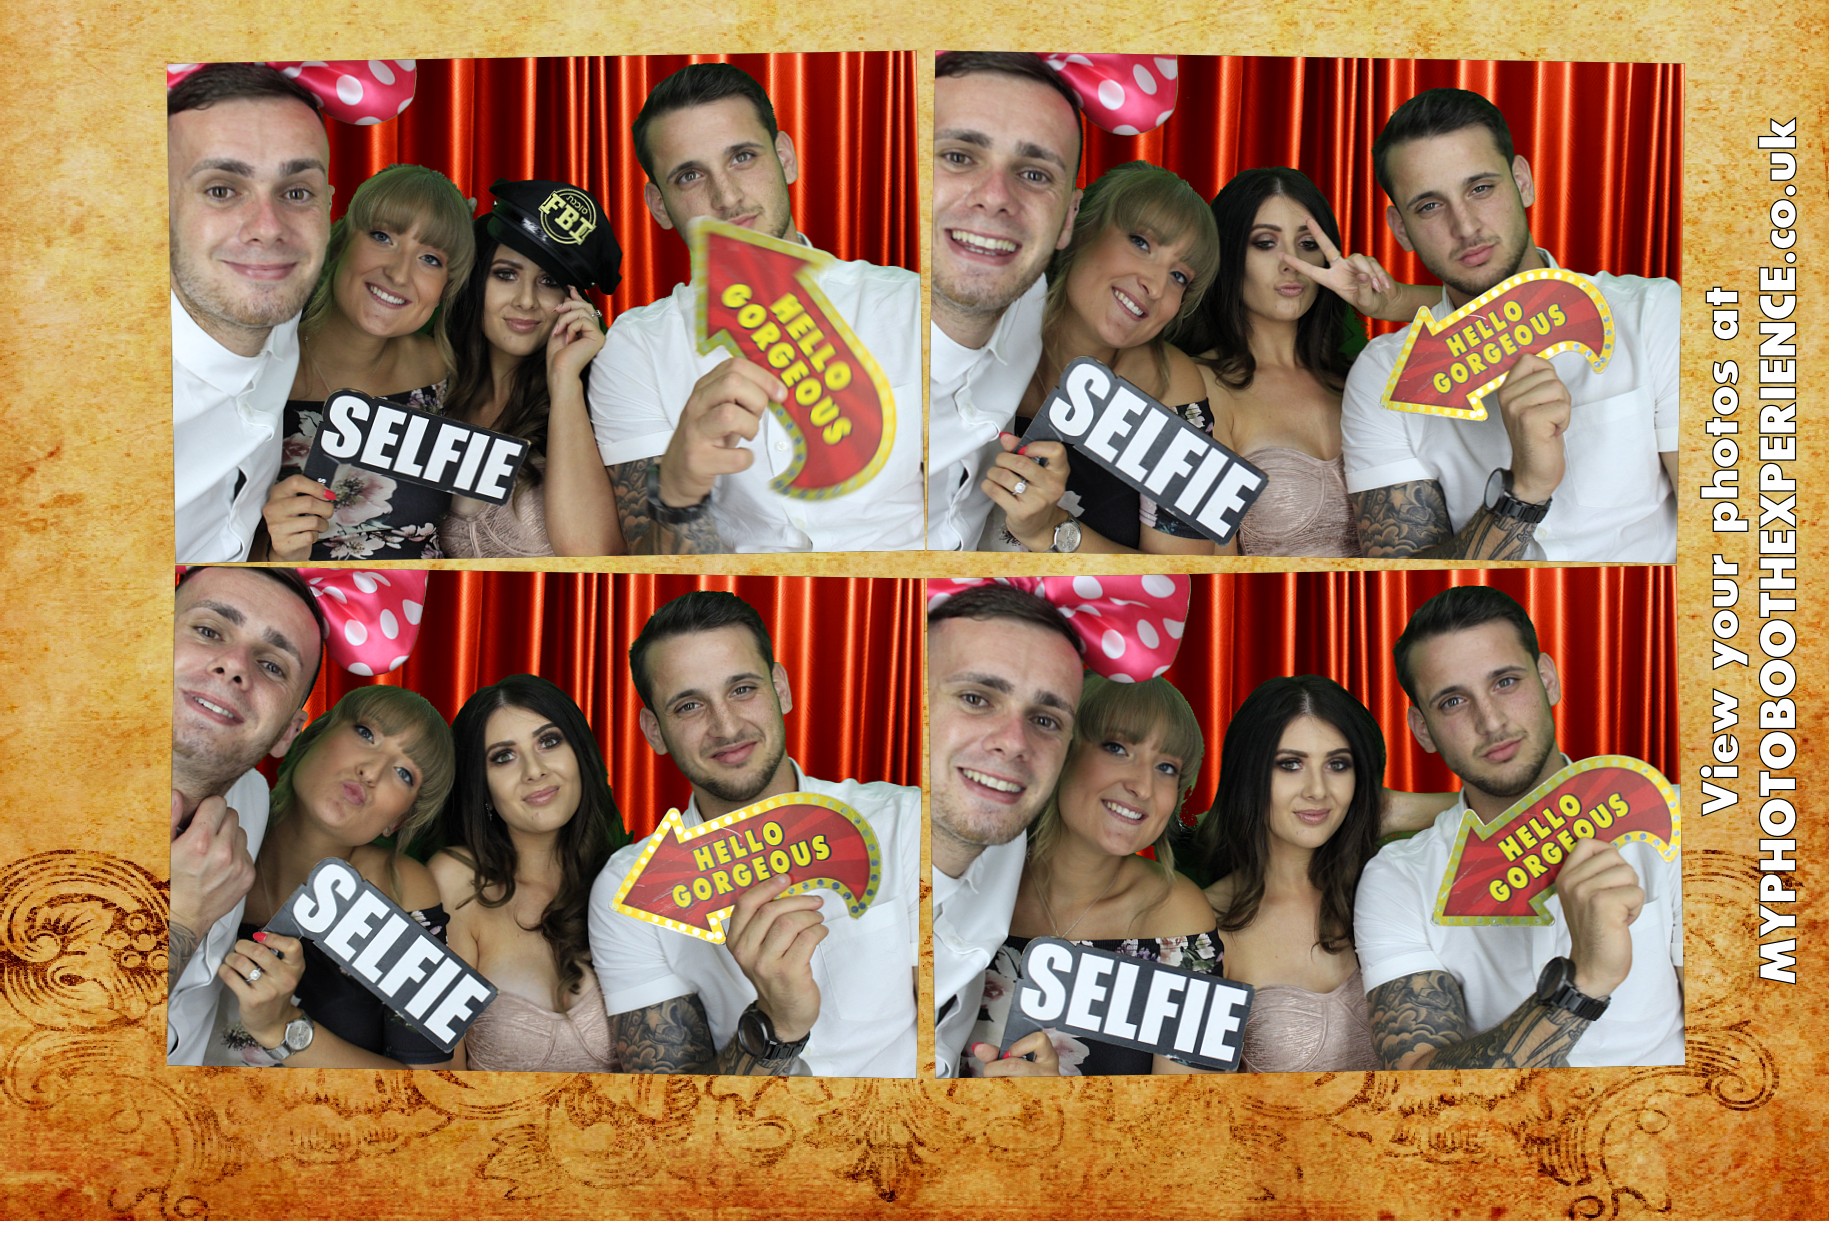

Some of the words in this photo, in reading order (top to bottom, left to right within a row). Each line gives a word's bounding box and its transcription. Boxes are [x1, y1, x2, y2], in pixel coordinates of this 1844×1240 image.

[539, 192, 596, 245] FBI
[721, 283, 853, 445] GORGEOUS
[769, 292, 852, 391] HELLO
[1432, 303, 1568, 395] GORGEOUS
[1445, 300, 1523, 358] HELLO
[320, 395, 523, 500] SELFIE
[1048, 363, 1262, 539] SELFIE
[672, 834, 832, 909] GORGEOUS
[692, 821, 783, 872] HELLO
[1488, 793, 1630, 902] GORGEOUS
[1497, 793, 1582, 862] HELLO
[292, 863, 492, 1045] SELFIE
[1019, 942, 1249, 1063] SELFIE
